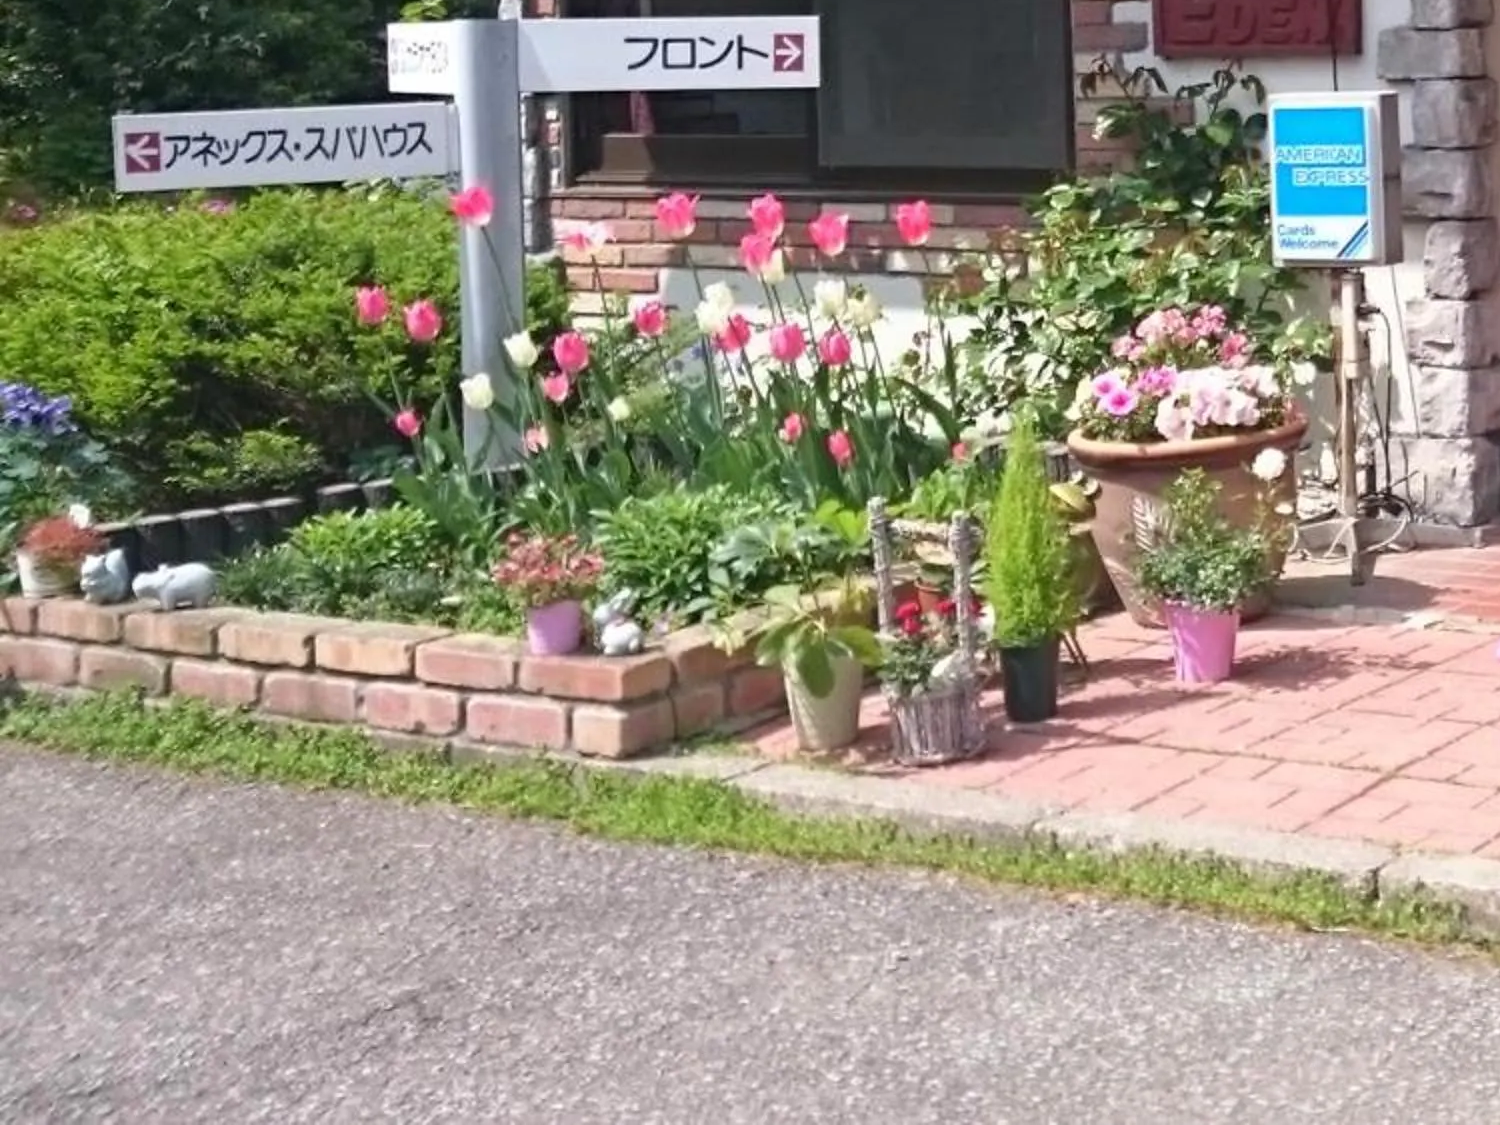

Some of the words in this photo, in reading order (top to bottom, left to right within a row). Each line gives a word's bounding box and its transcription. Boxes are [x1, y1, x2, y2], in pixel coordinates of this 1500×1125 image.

[624, 33, 769, 70] フロント
[1277, 146, 1361, 162] AMERICAN
[1295, 169, 1370, 185] EXPRESS
[1277, 224, 1315, 236] Cards
[1279, 237, 1339, 250] Welcome
